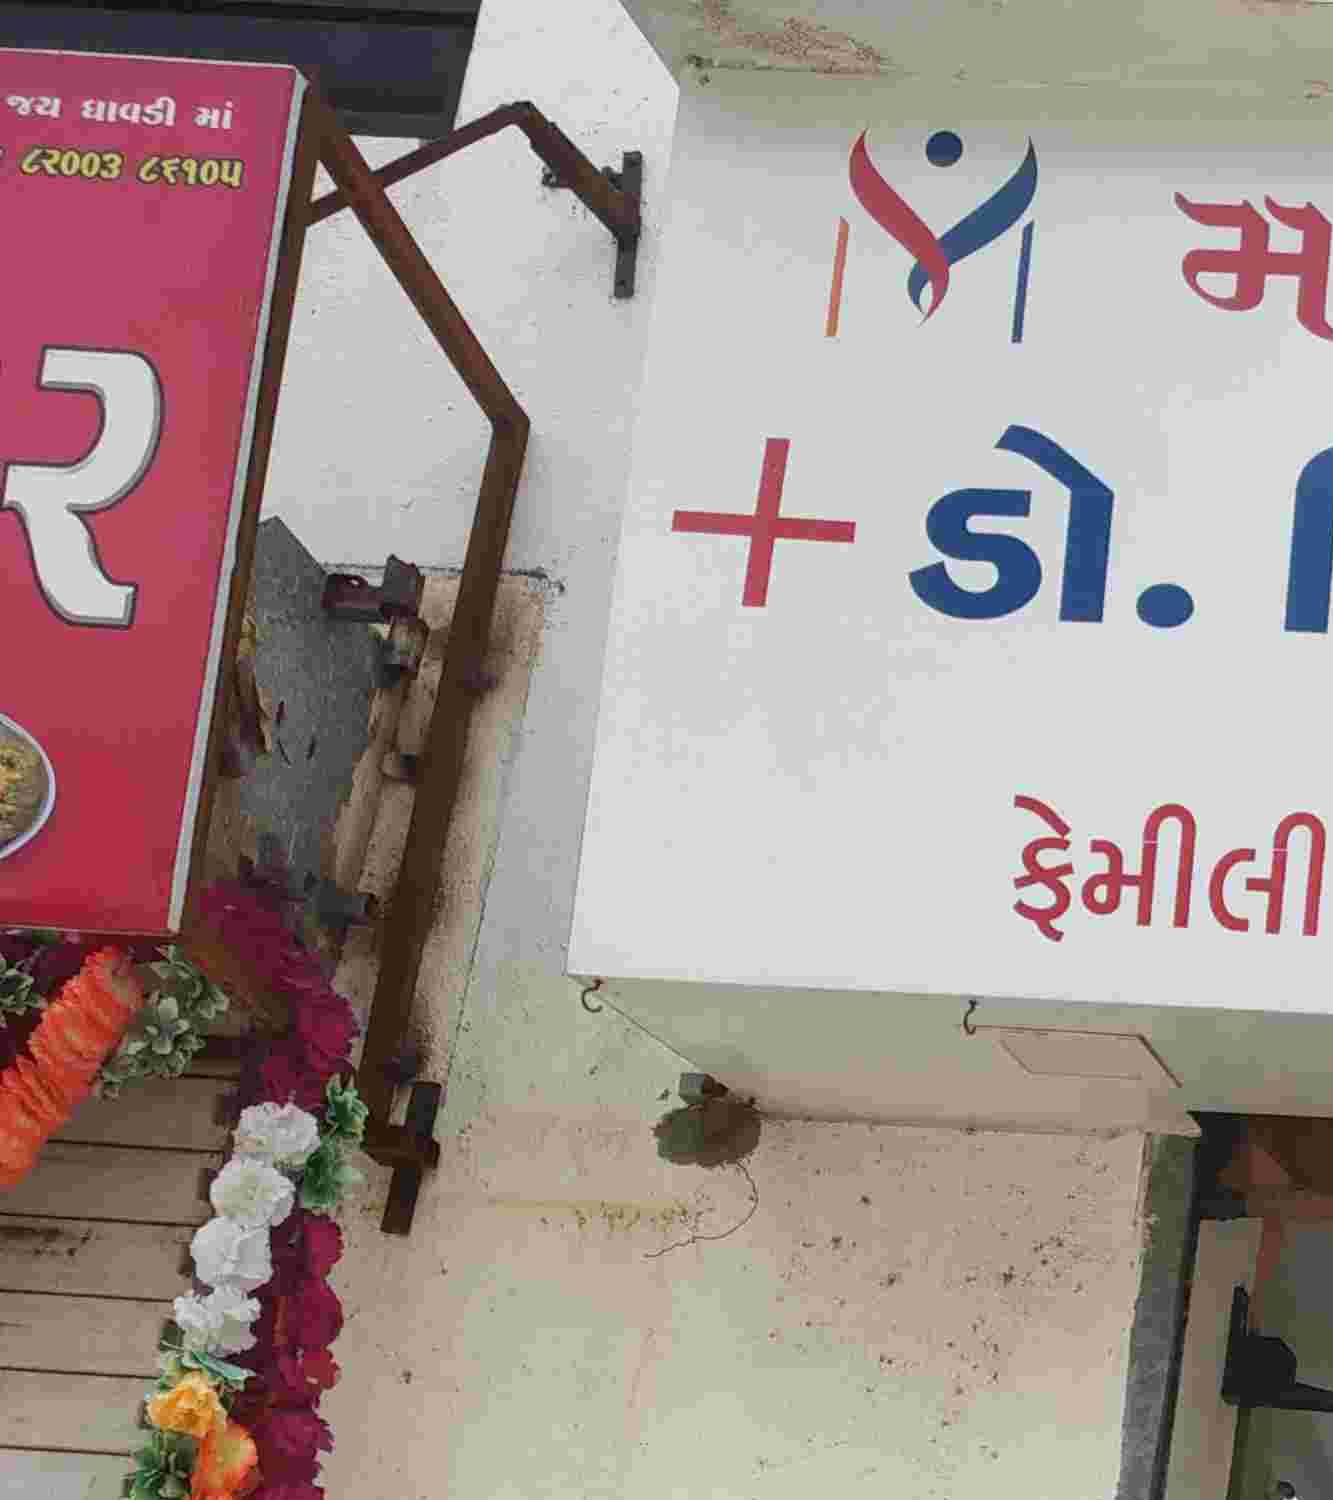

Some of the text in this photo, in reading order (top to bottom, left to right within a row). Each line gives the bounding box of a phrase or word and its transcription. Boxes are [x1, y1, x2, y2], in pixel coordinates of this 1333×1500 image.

[6, 94, 61, 119] જય
[193, 101, 234, 130] માં
[908, 422, 1196, 630] ડો.
[1012, 794, 1327, 942] ફેમીલી
